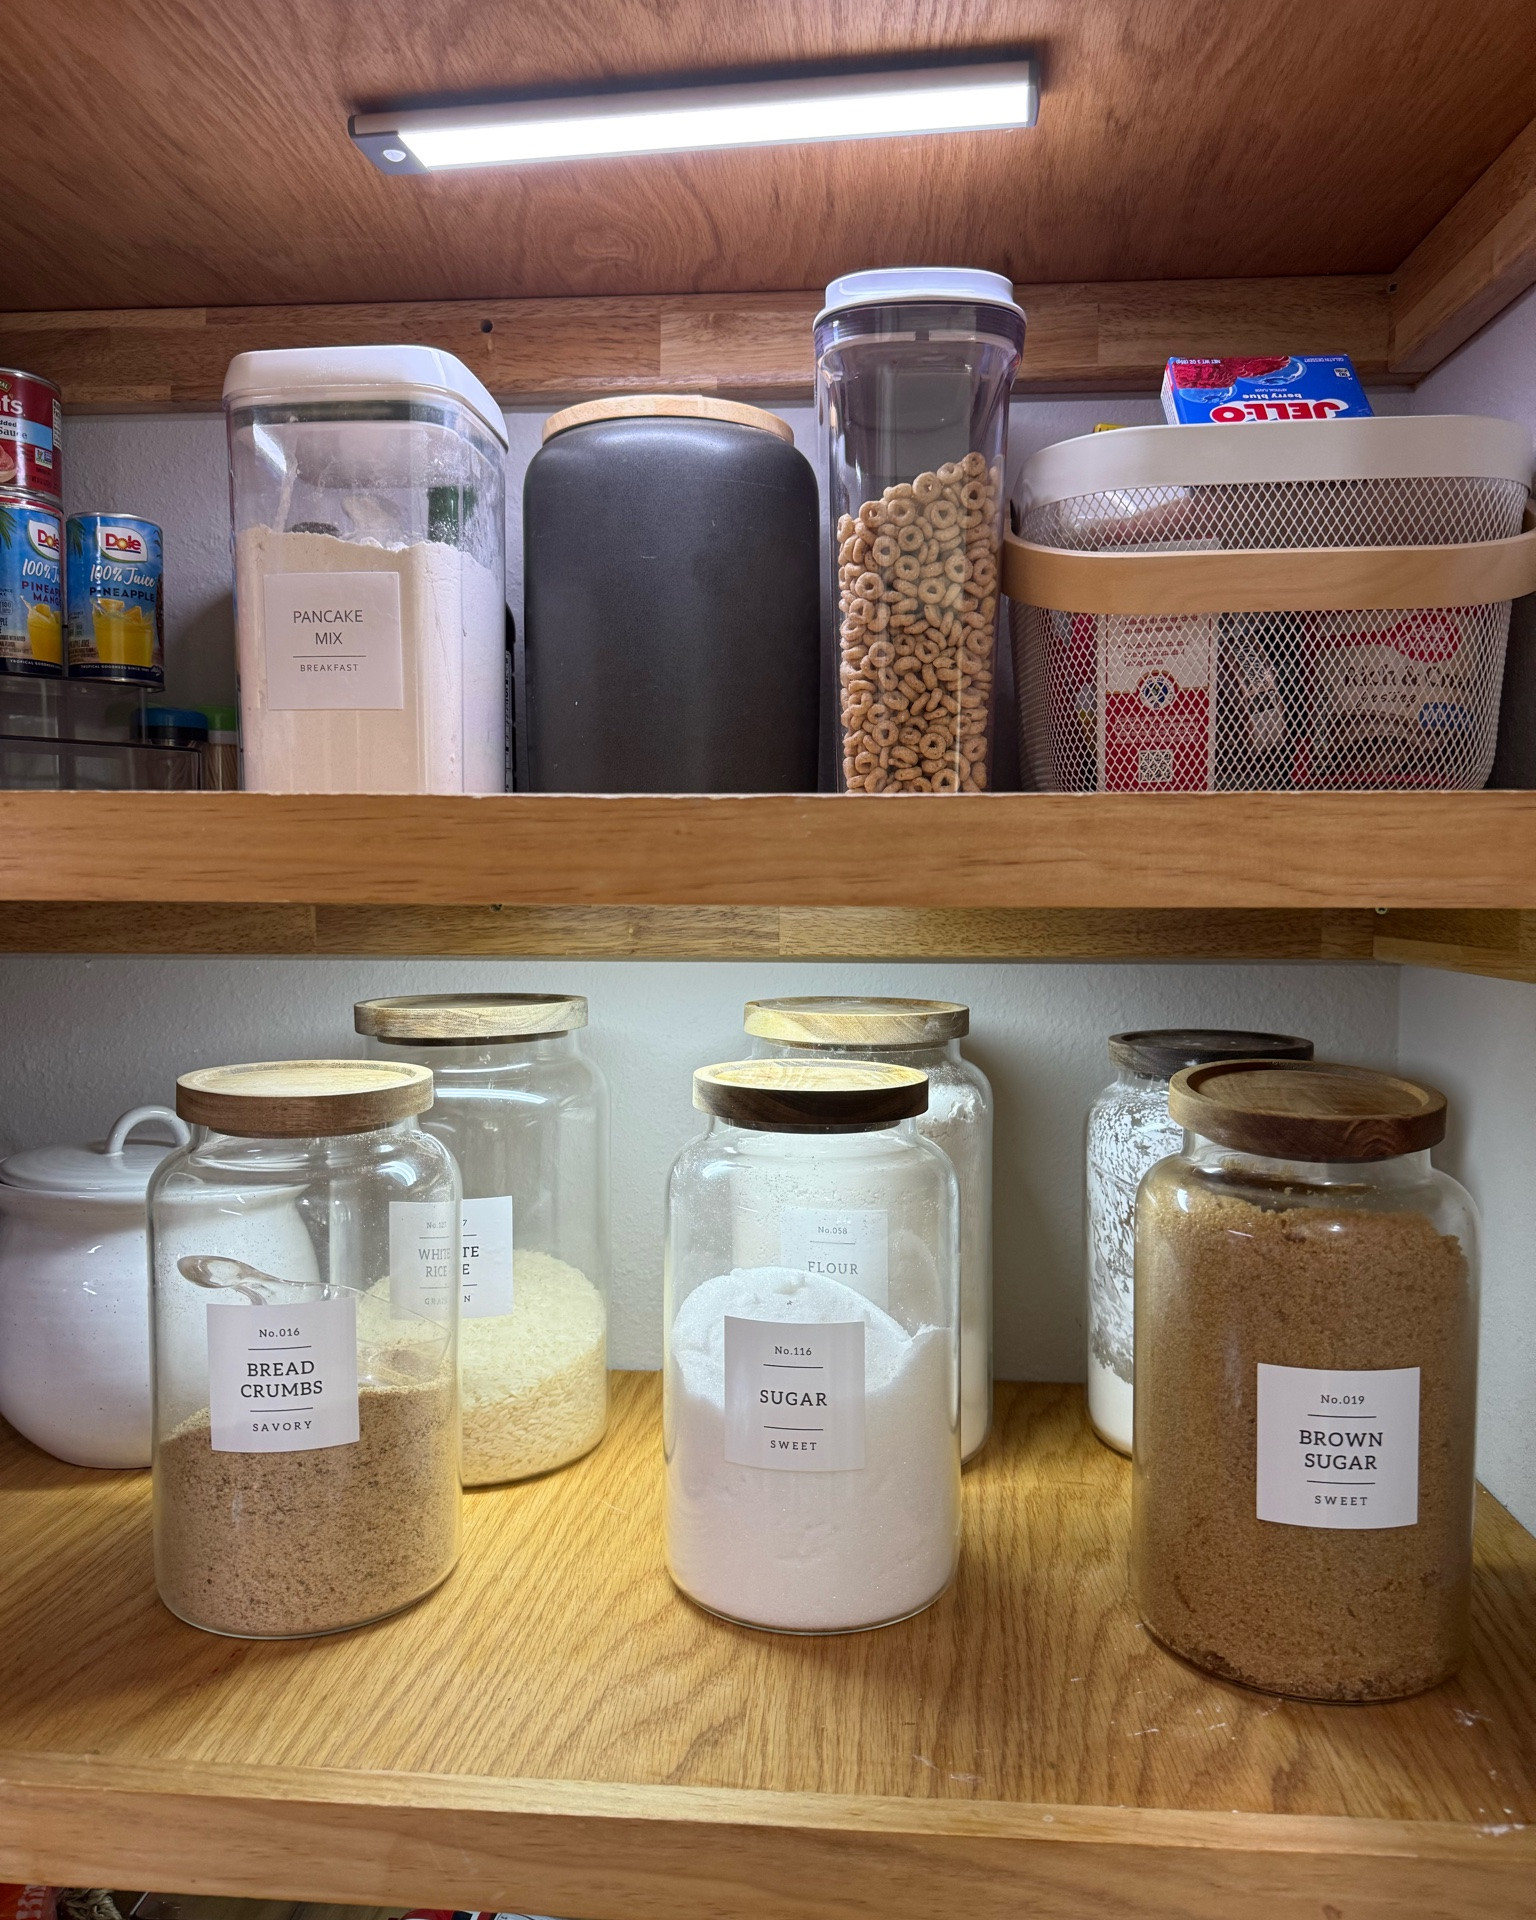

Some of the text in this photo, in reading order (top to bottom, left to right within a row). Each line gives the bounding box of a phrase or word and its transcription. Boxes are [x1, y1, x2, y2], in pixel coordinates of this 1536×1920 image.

[1271, 392, 1302, 400] berry
[38, 528, 60, 549] Dole
[105, 533, 142, 551] Dole
[22, 558, 50, 580] 100%
[90, 563, 156, 588] 100% Juice
[89, 586, 155, 602] PNEAPPLE
[293, 610, 364, 623] PANCAKE
[315, 632, 343, 645] MIX
[300, 663, 359, 672] BREAKFAST
[807, 1261, 859, 1275] FLOUR
[259, 1327, 300, 1338] No.016
[774, 1346, 812, 1356] No.116
[247, 1360, 315, 1377] BREAD
[240, 1380, 323, 1398] CRUMBS
[759, 1389, 828, 1407] SUGAR
[1320, 1394, 1365, 1405] No.019
[252, 1420, 312, 1432] SAVORY
[1299, 1429, 1384, 1447] BROWN
[770, 1440, 817, 1451] SWEET
[1304, 1453, 1378, 1470] SUGAR
[1314, 1495, 1368, 1506] SWEET
